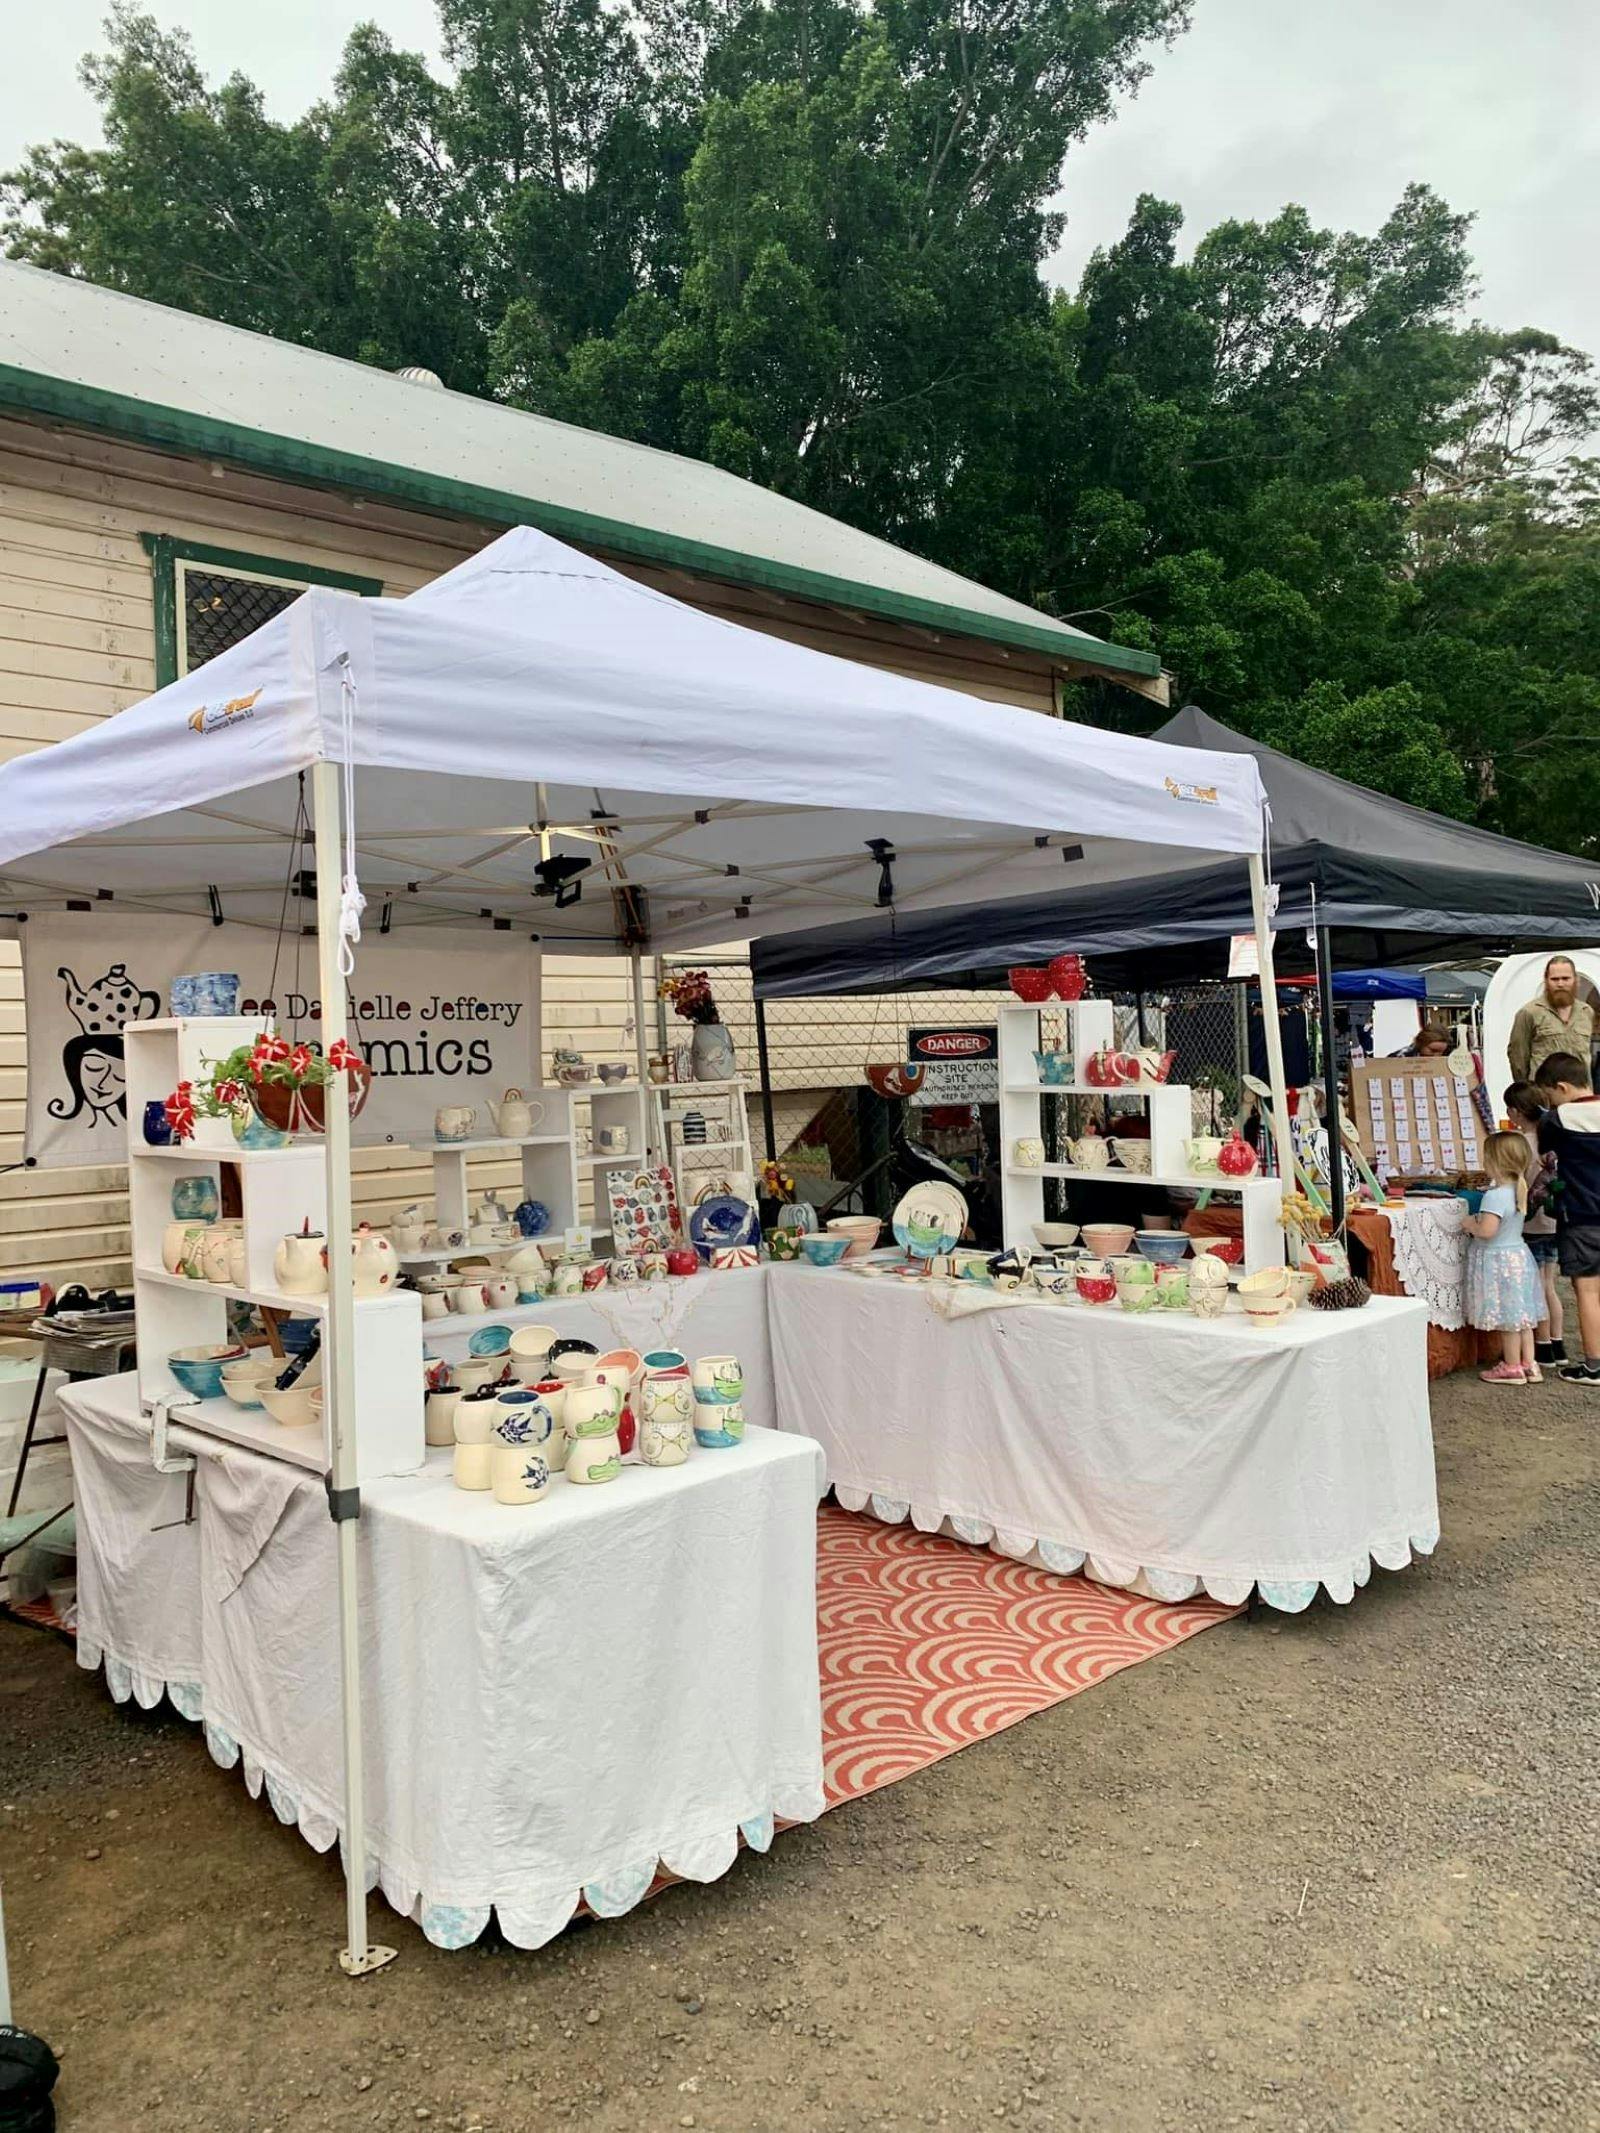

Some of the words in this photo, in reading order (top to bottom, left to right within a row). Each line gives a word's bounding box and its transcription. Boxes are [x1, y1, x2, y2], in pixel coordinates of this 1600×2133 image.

[284, 994, 412, 1020] Daielle
[420, 996, 523, 1028] Jeffery
[927, 1038, 980, 1050] DANGER
[928, 1062, 999, 1074] NSTRUCTION
[944, 1074, 968, 1084] SITE
[941, 1092, 958, 1100] KEEP
